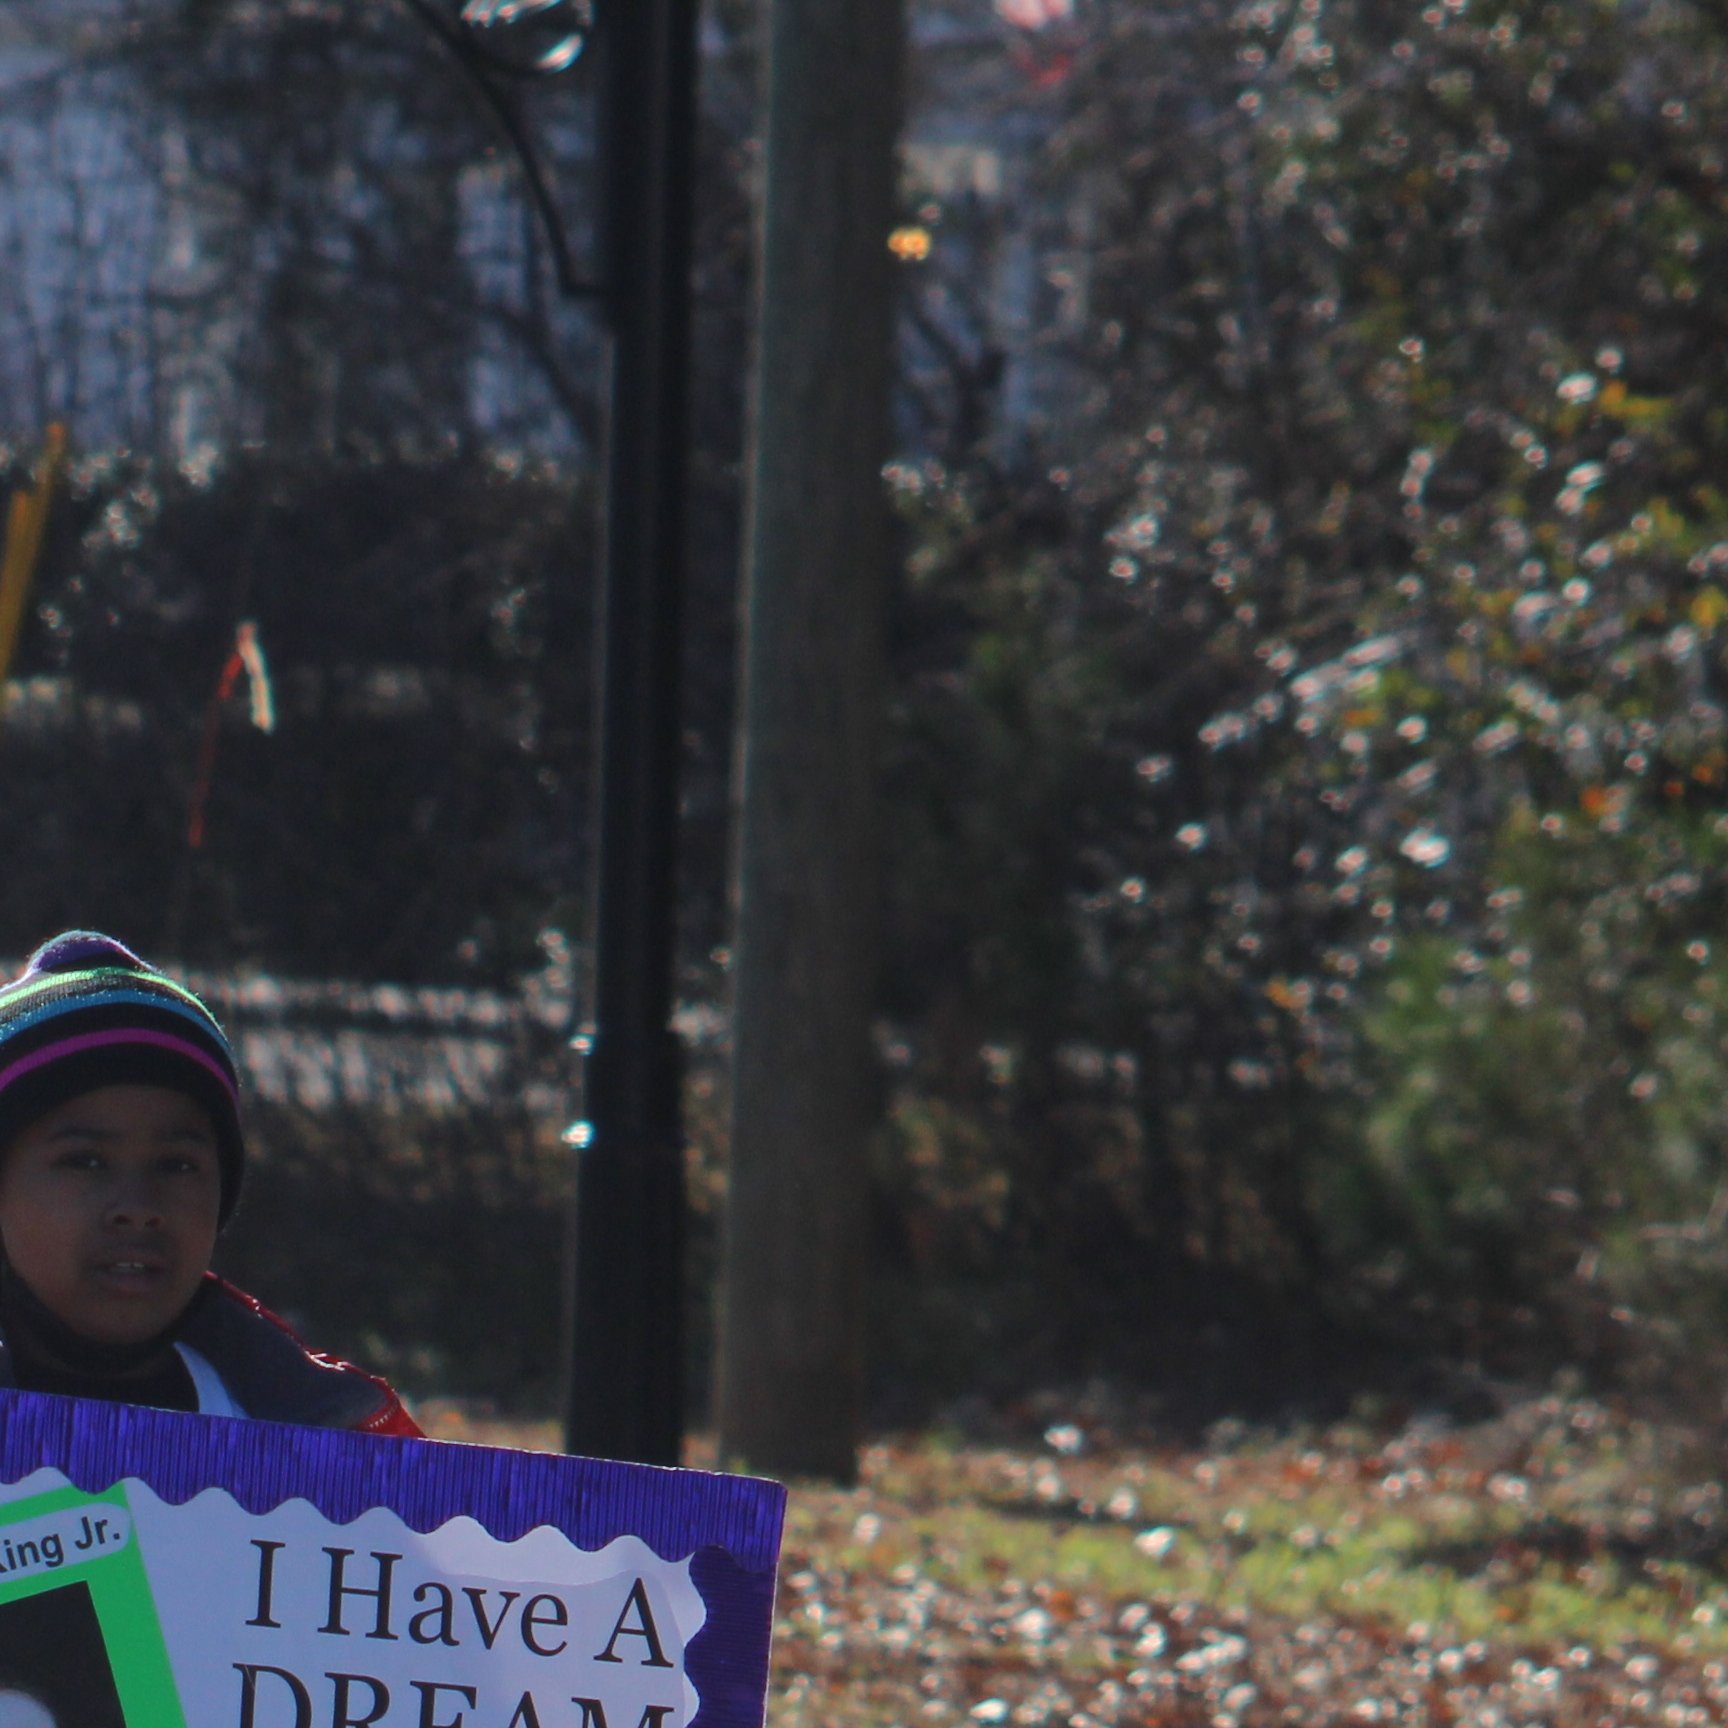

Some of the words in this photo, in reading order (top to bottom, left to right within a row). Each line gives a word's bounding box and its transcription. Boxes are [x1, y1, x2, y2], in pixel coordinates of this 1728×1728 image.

[73, 1515, 122, 1551] Jr.
[244, 1538, 287, 1629] I
[316, 1545, 569, 1658] Have
[592, 1576, 675, 1669] A
